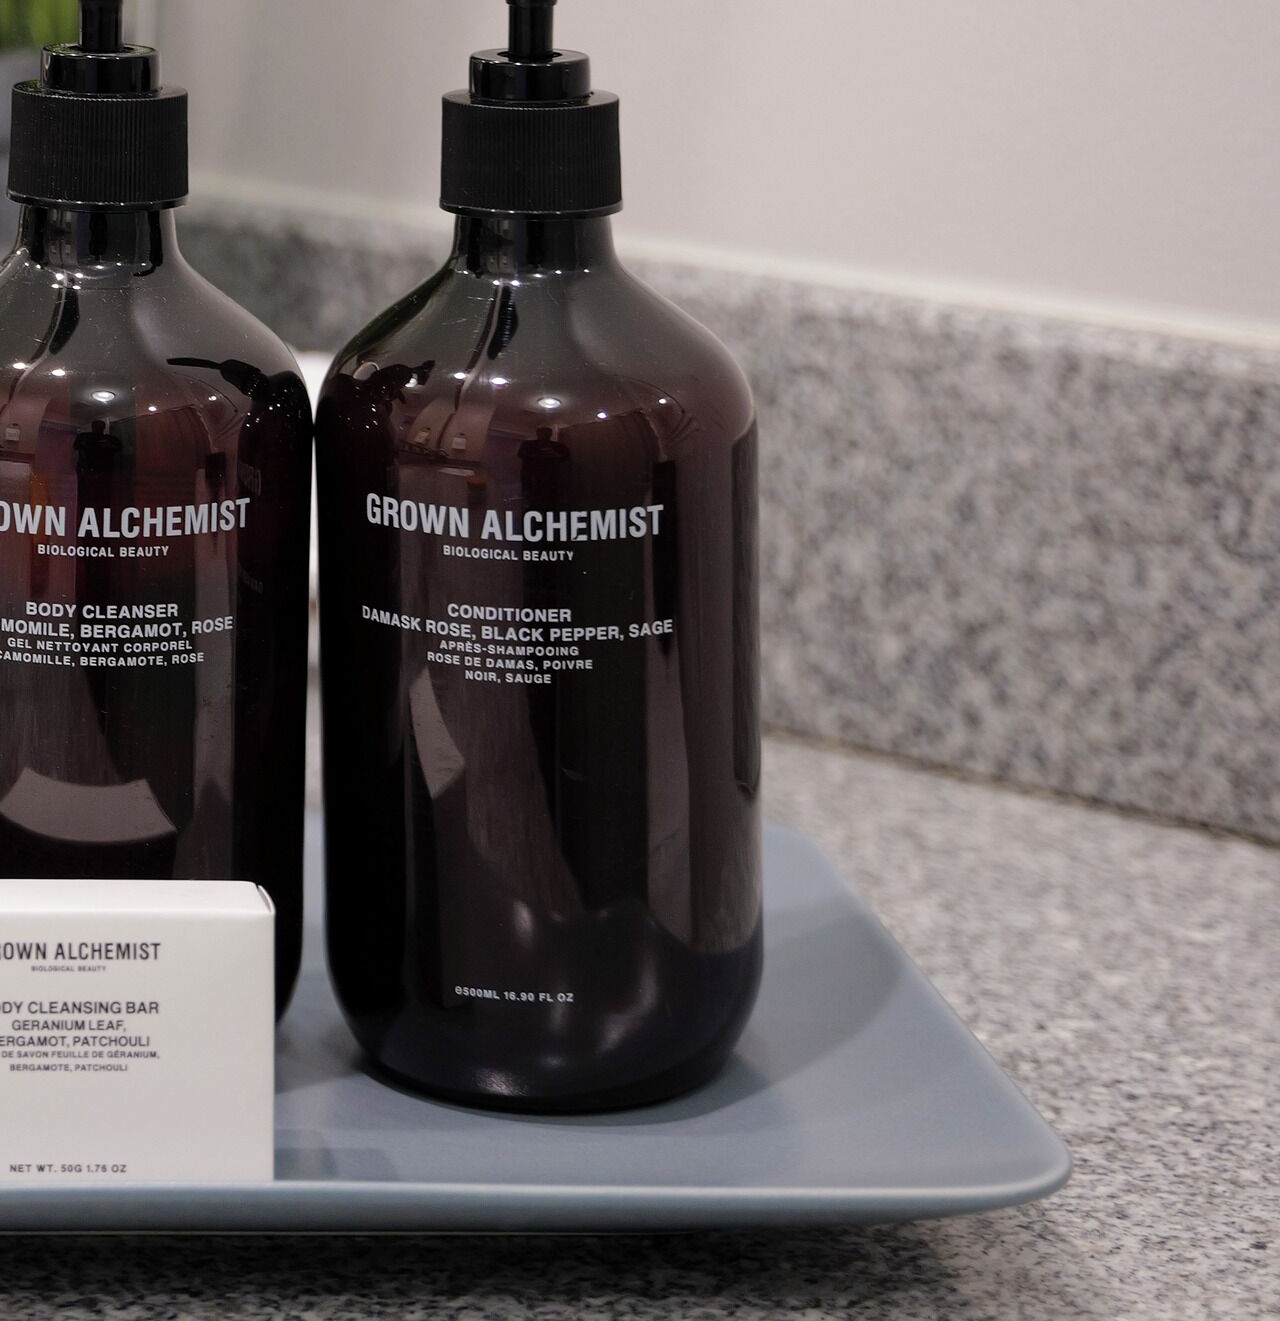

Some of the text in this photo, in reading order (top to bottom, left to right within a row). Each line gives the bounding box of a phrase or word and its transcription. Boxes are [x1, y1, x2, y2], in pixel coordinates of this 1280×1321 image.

[77, 496, 251, 539] ALCHEMIST
[366, 492, 665, 543] GROWN ALCHEMIST
[37, 543, 169, 558] BIOLOGICAL BEAUTY
[442, 544, 575, 562] BIOLOGICAL BEAUTY
[25, 600, 179, 620] BODY CLEANSER
[446, 602, 572, 623] CONDITIONER
[79, 621, 188, 639] BERGAMOT,
[191, 615, 234, 635] ROSE
[361, 604, 674, 642] DAMASK ROSE, BLACK PEPPER, SAGE
[6, 636, 193, 654] GEL NETTOYANT CORPOREL
[439, 639, 580, 657] APRÈS-SHAMPOOING
[79, 655, 168, 668] BERGAMOTE,
[171, 651, 205, 665] ROSE
[426, 650, 593, 672] ROSE DE DAMAS, POIVRE
[464, 669, 552, 685] NOIR, SAUGE
[53, 941, 161, 961] ALCHEMIST
[503, 991, 535, 1001] 16.90
[538, 992, 554, 1002] FL
[556, 992, 574, 1002] OZ
[27, 1000, 122, 1015] CLEANSING
[125, 1000, 160, 1015] BAR
[11, 1019, 127, 1033] GERANIUM LEAF,
[72, 1035, 150, 1048] PATCHOULI
[1, 1050, 14, 1059] DE
[16, 1050, 48, 1059] SAVON
[50, 1050, 89, 1059] FEUILLE
[91, 1050, 104, 1059] DE
[106, 1048, 160, 1060] GÉRANIUM,
[9, 1063, 128, 1073] BERGAMOTE, PATCHOULI
[9, 1163, 127, 1174] NET WT. 50G 1.76 OZ
